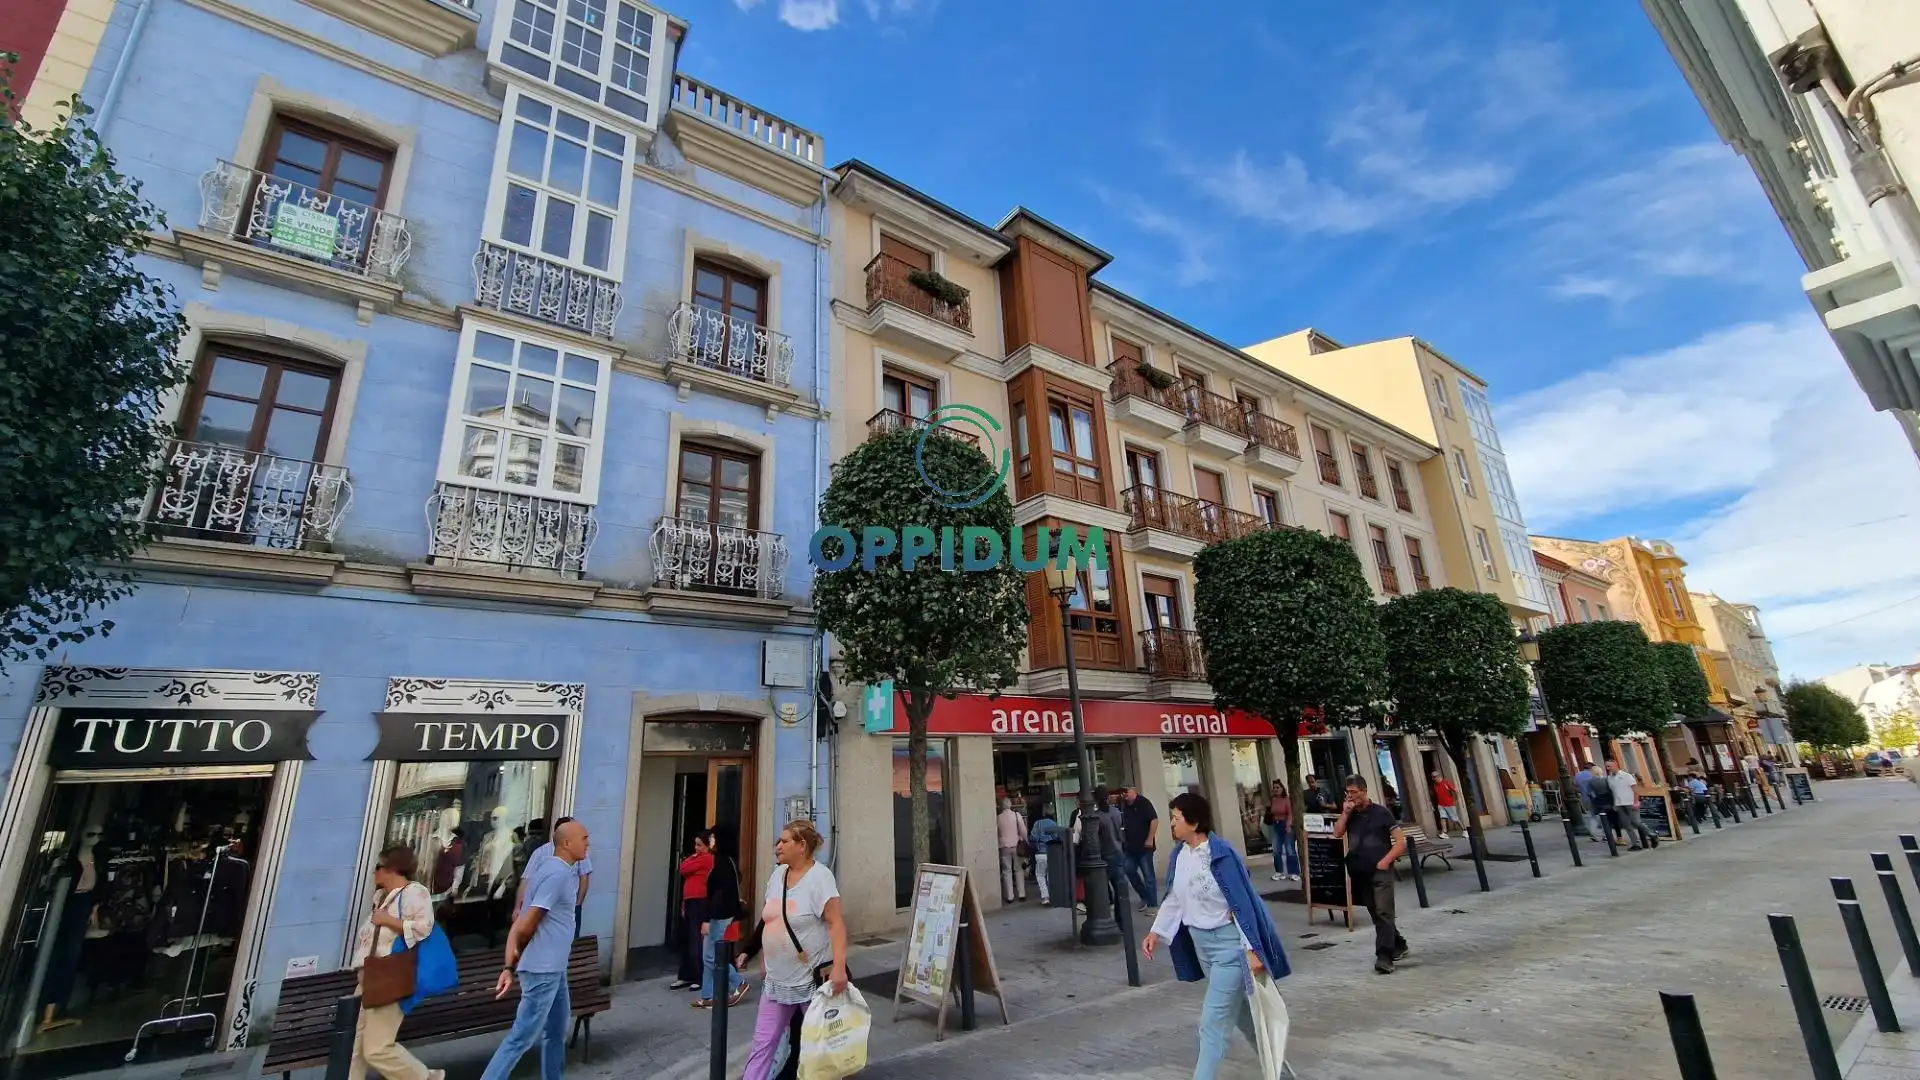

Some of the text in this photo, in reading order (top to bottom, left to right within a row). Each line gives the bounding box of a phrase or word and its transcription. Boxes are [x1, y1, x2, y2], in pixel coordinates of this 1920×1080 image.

[279, 215, 332, 235] SE VENDE
[991, 704, 1085, 733] arena
[1160, 711, 1228, 734] arenal
[73, 718, 272, 753] TUTTO
[414, 722, 560, 751] TEMPO
